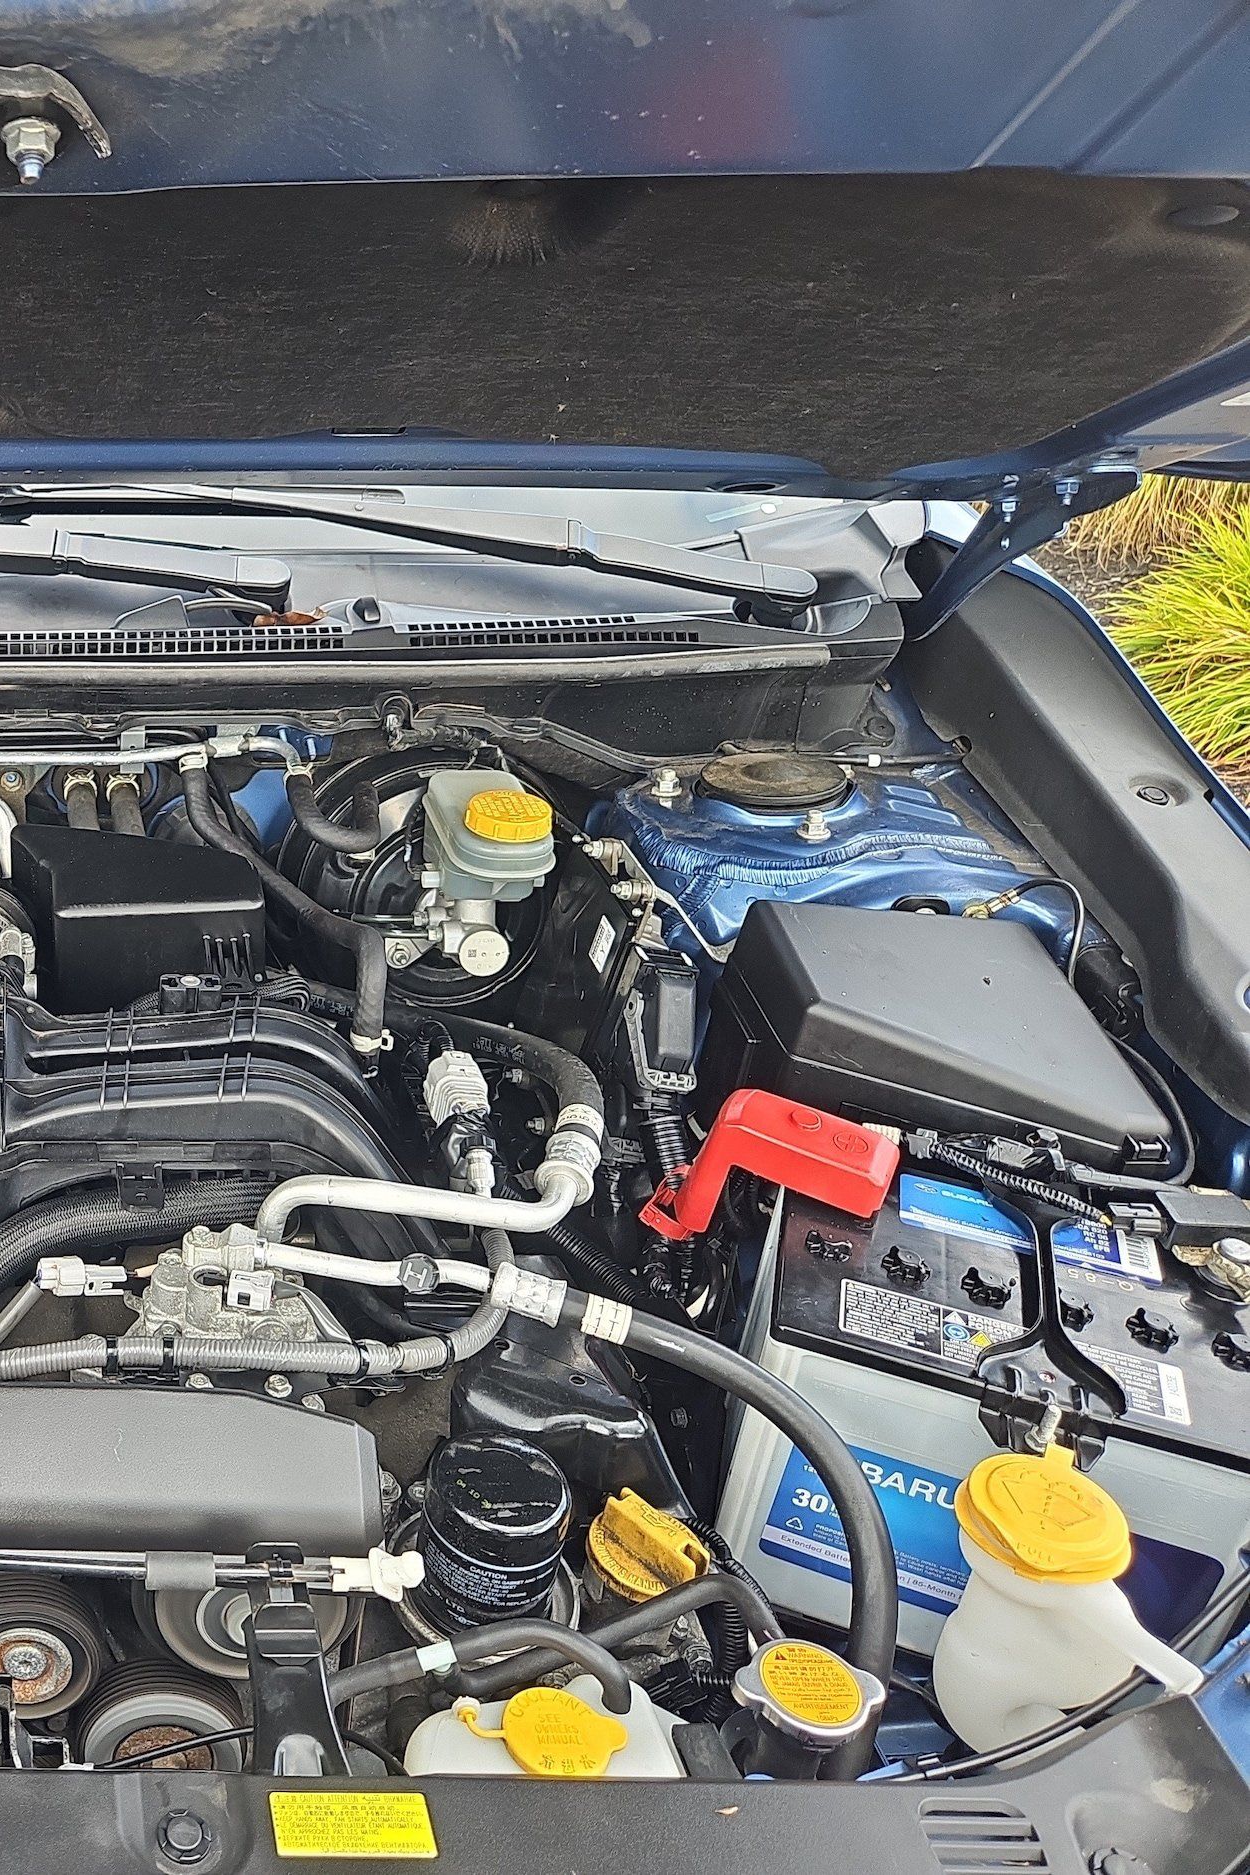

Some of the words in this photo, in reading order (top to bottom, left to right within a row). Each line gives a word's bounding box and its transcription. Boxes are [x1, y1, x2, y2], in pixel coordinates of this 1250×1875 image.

[403, 1261, 428, 1288] H
[856, 1459, 955, 1510] BARU
[791, 1487, 829, 1514] 30
[780, 1534, 823, 1553] Extended
[824, 1550, 851, 1563] Batte
[469, 1565, 508, 1580] CAUTION
[508, 1689, 592, 1718] COOLANT
[793, 1702, 849, 1710] AVERTISSEMENT
[538, 1712, 562, 1724] SEE
[534, 1723, 580, 1734] OWNERS
[536, 1734, 584, 1746] MANUAL
[327, 1795, 359, 1803] ATTENTION
